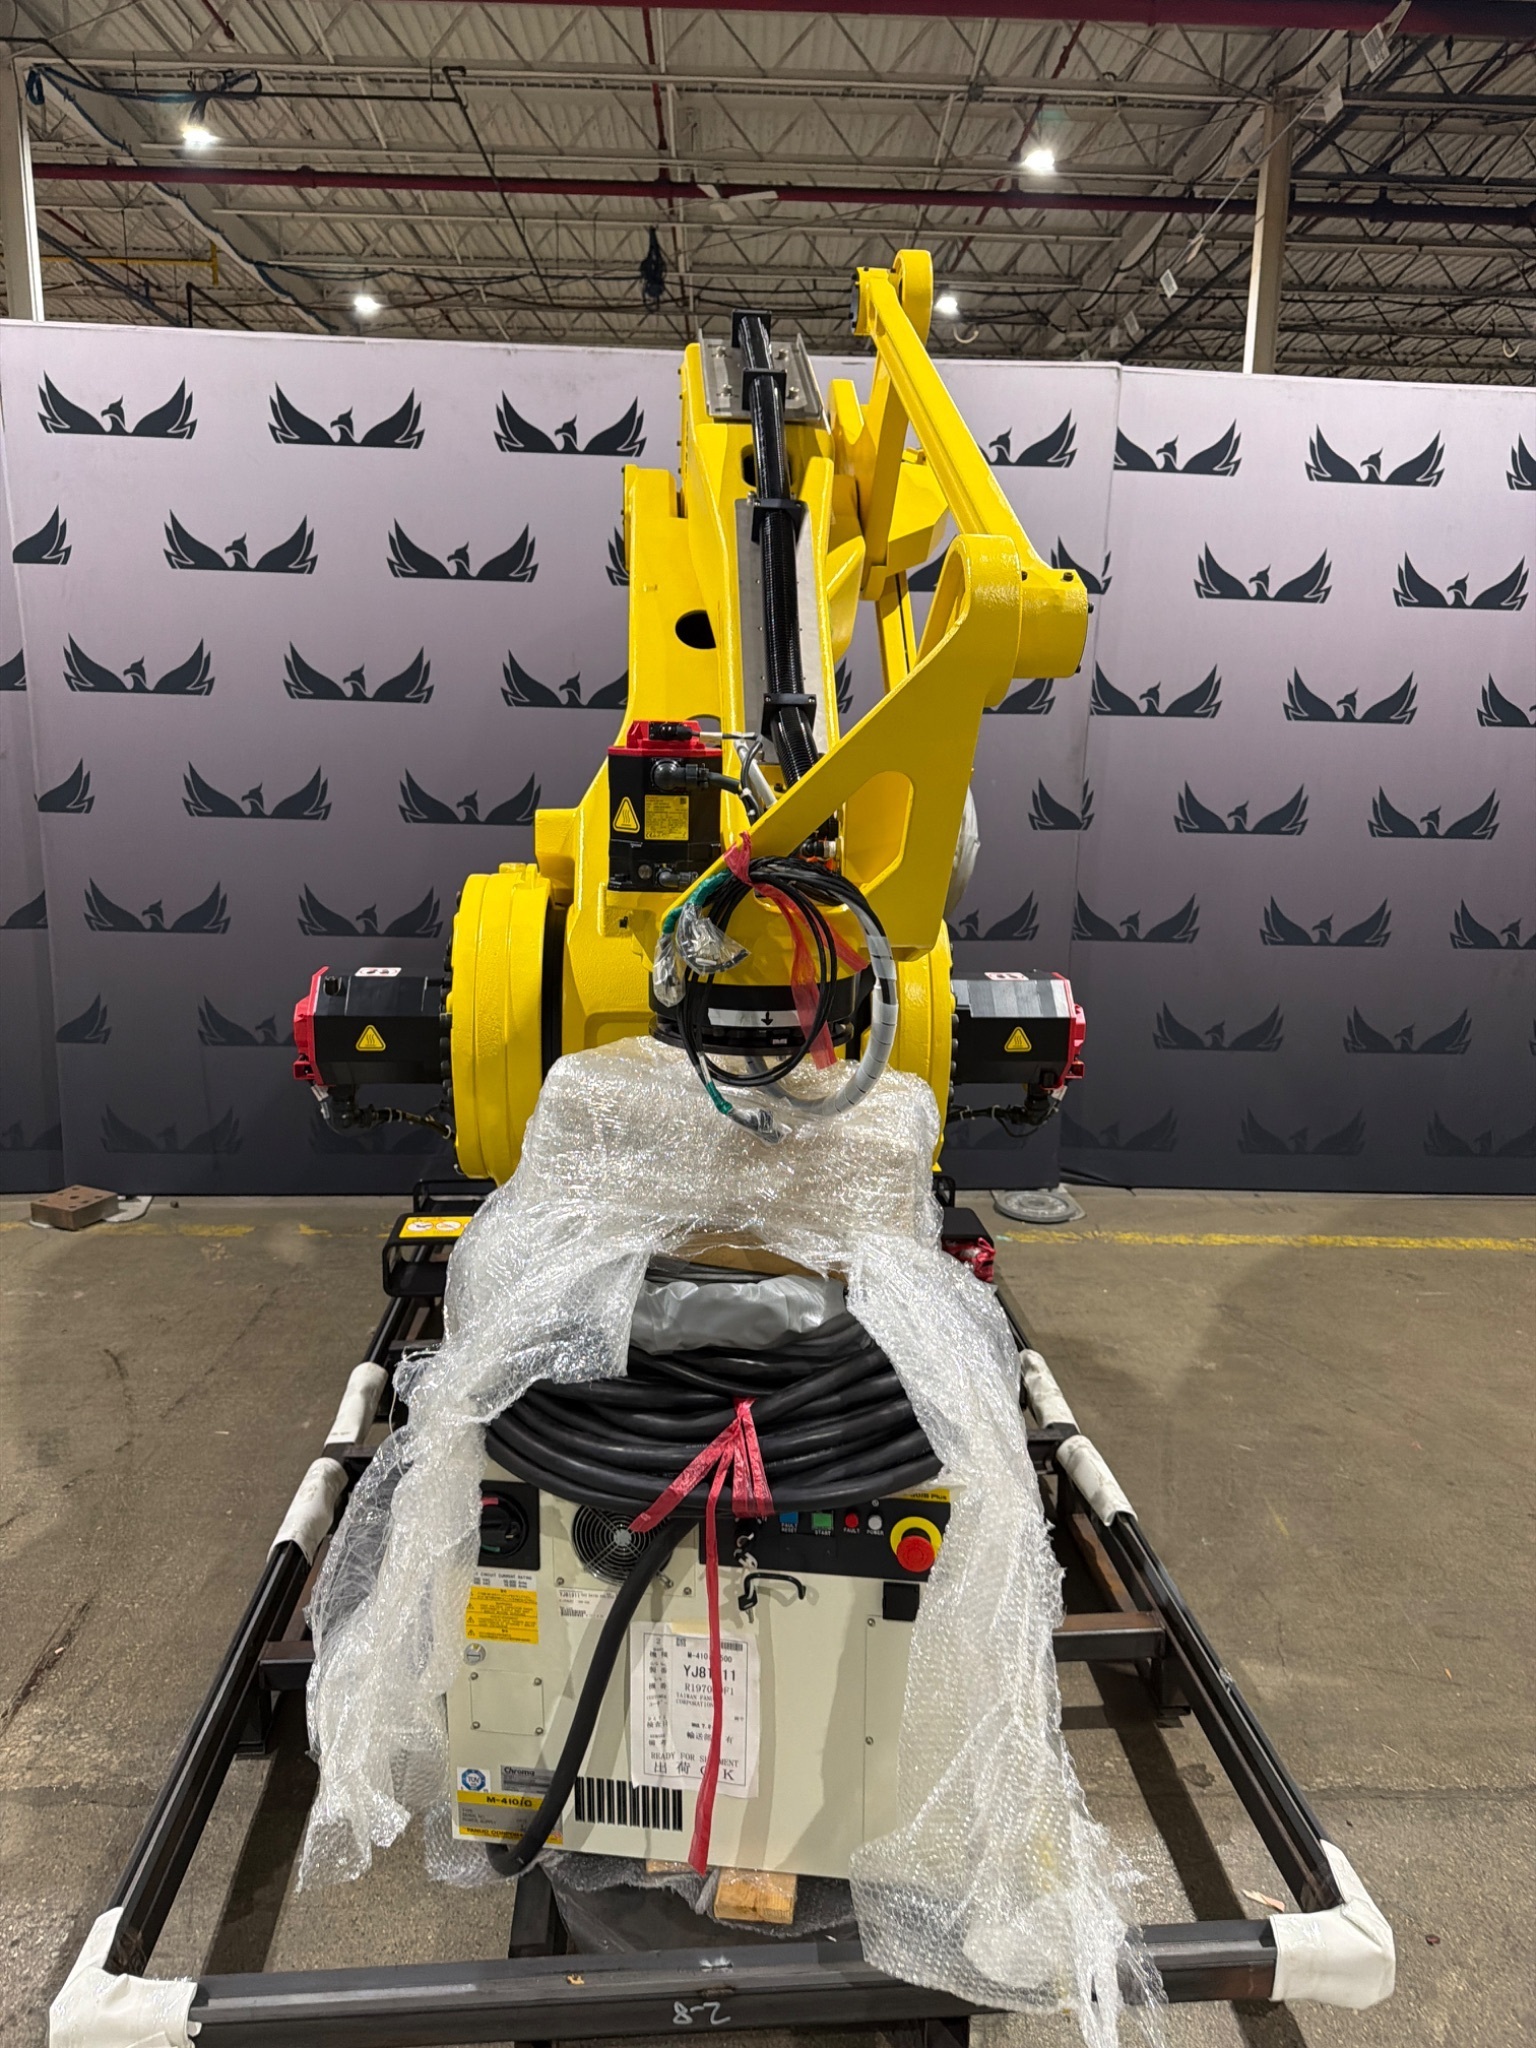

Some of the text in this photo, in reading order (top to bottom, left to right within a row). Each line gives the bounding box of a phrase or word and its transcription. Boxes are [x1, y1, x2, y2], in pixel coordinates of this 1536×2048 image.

[814, 1529, 832, 1537] START
[843, 1527, 860, 1535] FAULT
[866, 1529, 885, 1537] POWER
[683, 1664, 736, 1682] YJ8111
[650, 1751, 676, 1760] READY
[680, 1752, 695, 1761] FOR
